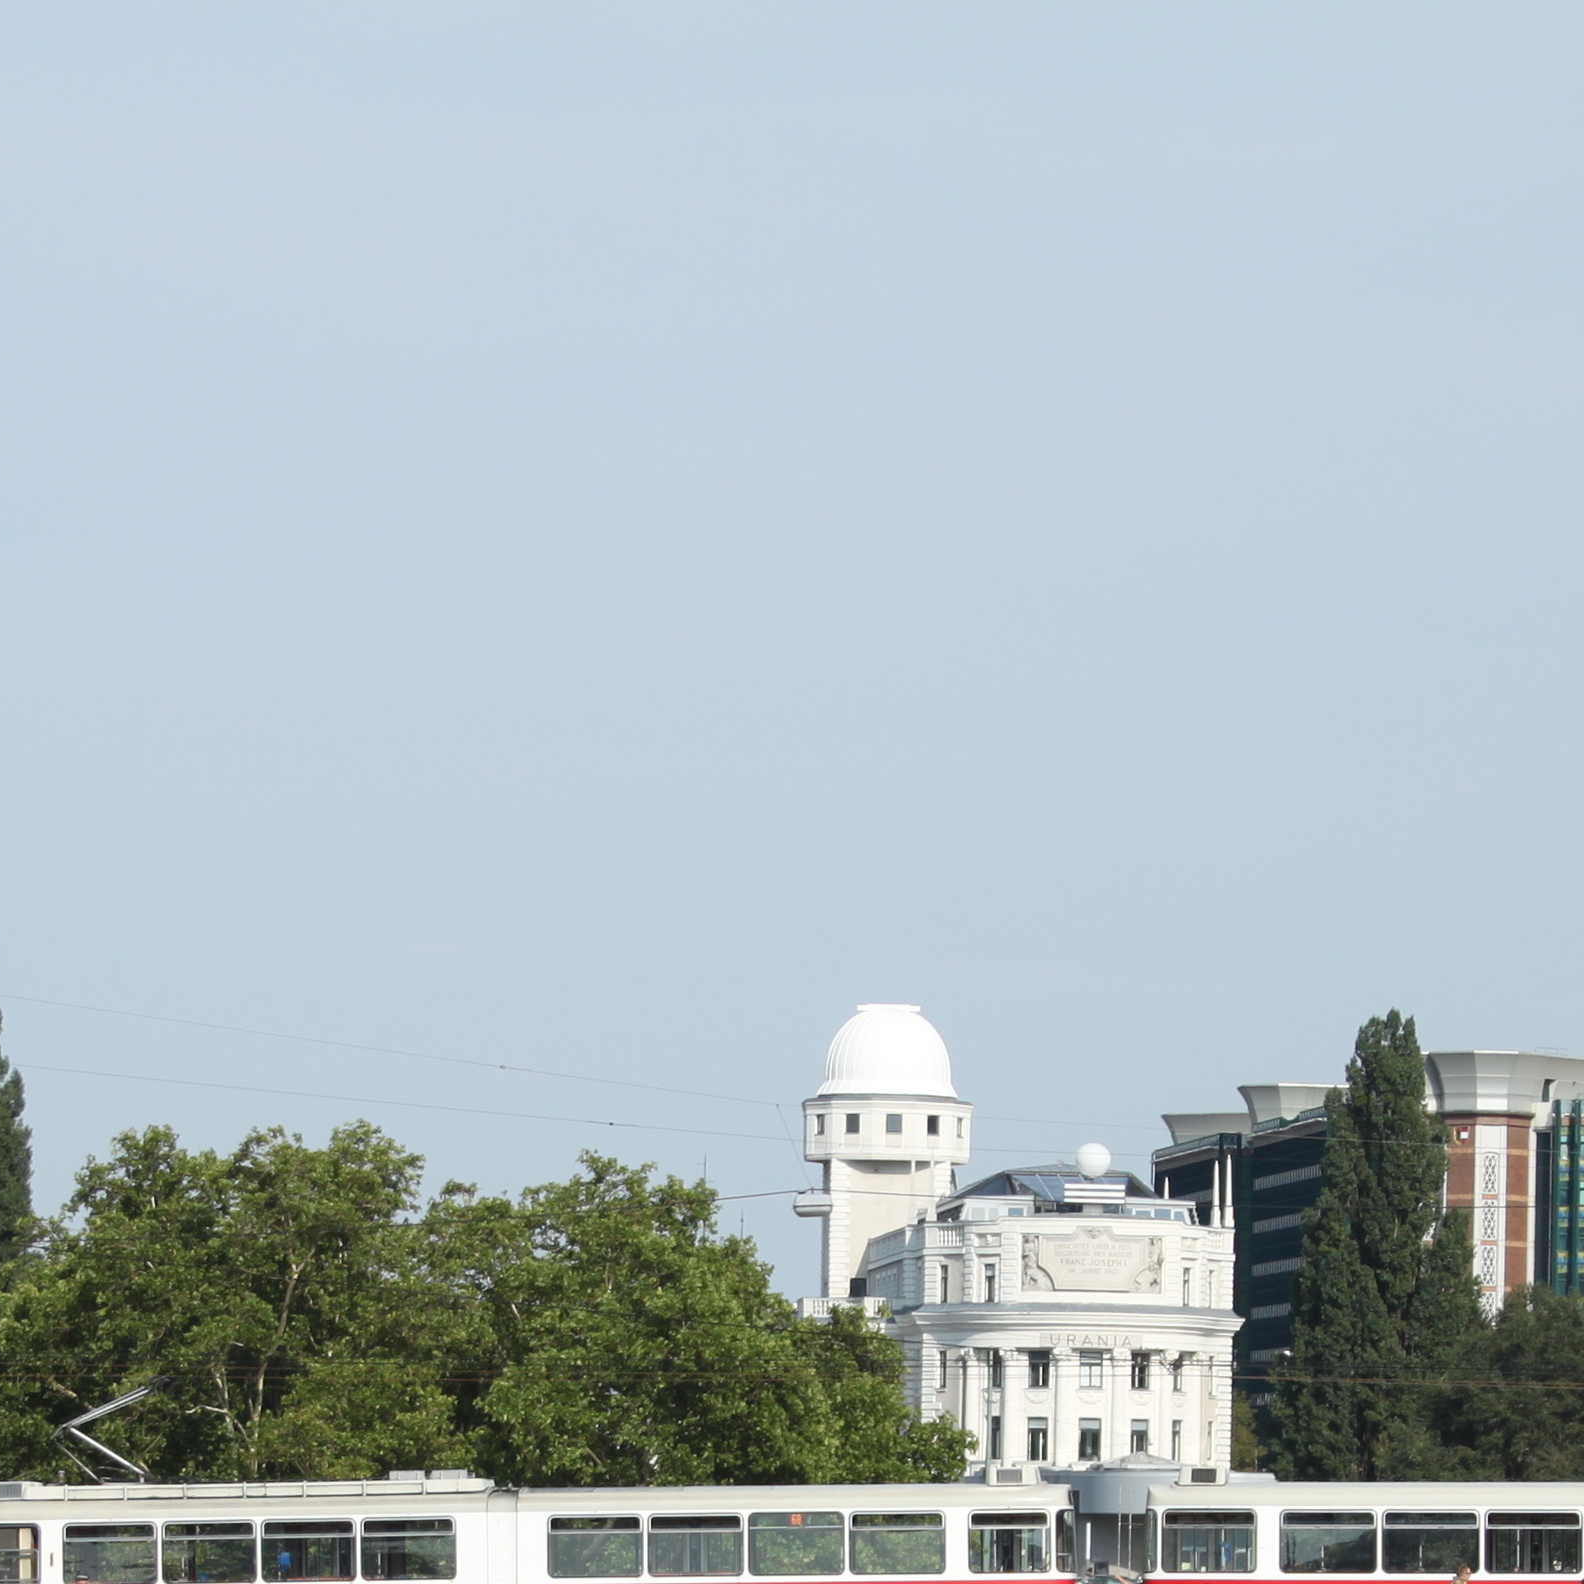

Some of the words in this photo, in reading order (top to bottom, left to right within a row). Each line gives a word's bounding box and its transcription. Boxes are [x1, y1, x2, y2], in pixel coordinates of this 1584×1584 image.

[1060, 1258, 1085, 1266] FRANZ
[1089, 1258, 1122, 1267] JOSEPH
[1050, 1334, 1133, 1347] URANIA
